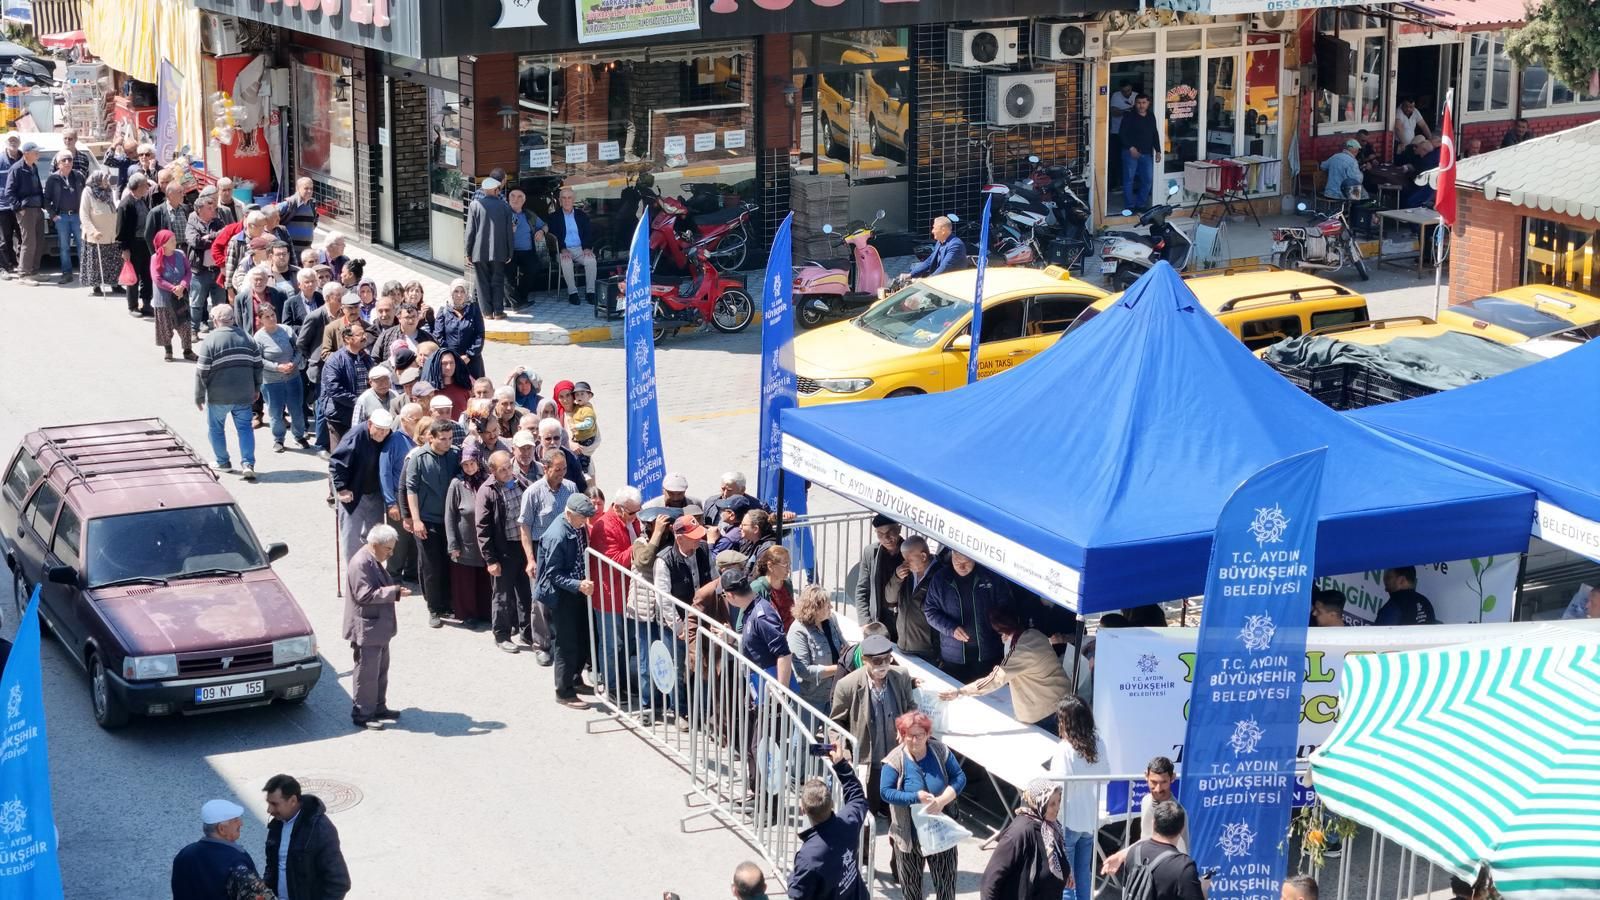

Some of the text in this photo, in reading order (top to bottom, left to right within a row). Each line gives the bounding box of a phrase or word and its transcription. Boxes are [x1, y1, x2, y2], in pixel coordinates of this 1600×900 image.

[1267, 0, 1300, 10] 0535
[848, 479, 874, 500] AYDIN
[875, 489, 946, 534] BÜYÜKŞEHİR
[948, 525, 1007, 564] BELEDİYESİ
[1542, 516, 1600, 547] BELEDİYES
[1232, 550, 1300, 564] T.C. AYDIN
[1219, 564, 1308, 582] BÜYÜKŞEHİR
[1223, 581, 1301, 597] BELEDİYESİ
[1221, 655, 1288, 670] T.C. AYDIN
[1119, 681, 1175, 691] BÜYÜKŞEHİR
[1210, 669, 1297, 686] BÜYÜKŞEHİR
[203, 681, 262, 699] 09 NY 155
[1212, 686, 1290, 702] BELEDİYESİ
[1236, 760, 1279, 772] AYDIN
[1199, 774, 1287, 791] BÜYÜKŞEHİR
[1203, 791, 1281, 808] BELEDİYESİ
[0, 840, 48, 865] ÜKŞEHİR
[1230, 863, 1271, 876] AYDIN
[1209, 877, 1280, 894] YÜKŞEHİR
